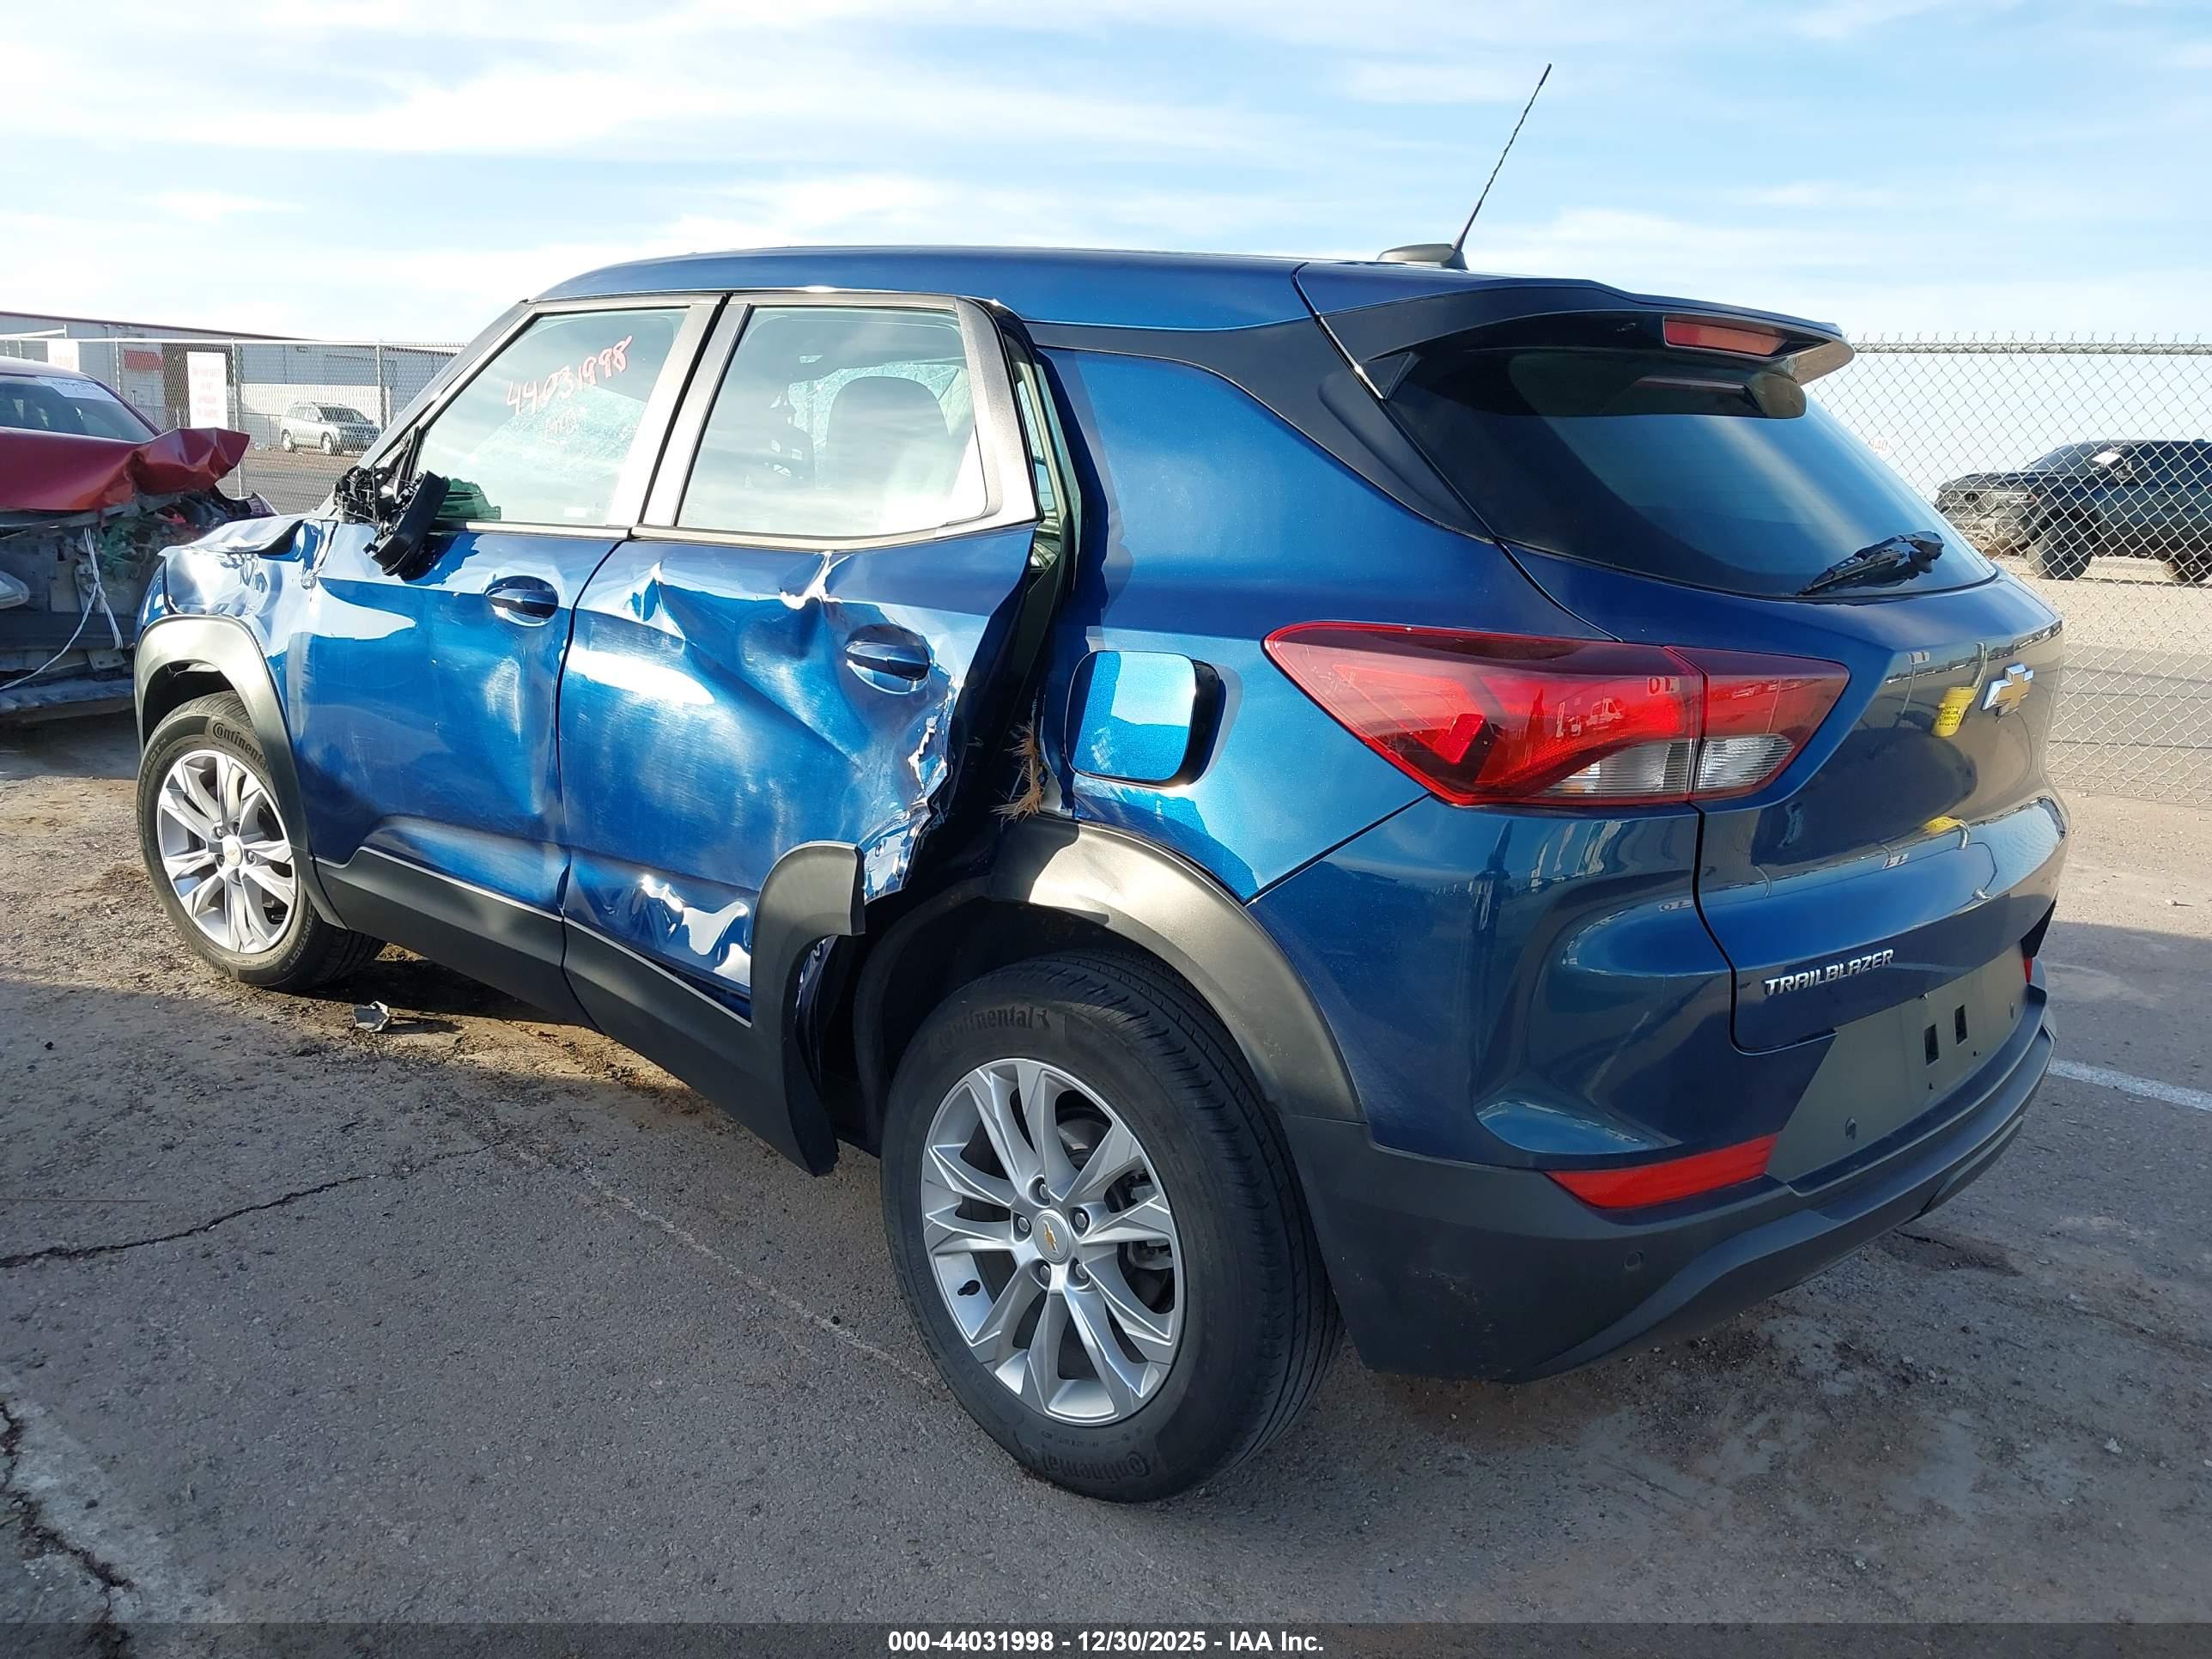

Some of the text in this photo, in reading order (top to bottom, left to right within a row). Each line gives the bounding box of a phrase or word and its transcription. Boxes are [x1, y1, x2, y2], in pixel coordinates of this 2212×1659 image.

[505, 335, 633, 416] 44031998
[212, 722, 269, 770] Continenta
[1765, 949, 1894, 996] TRAILBLAZER
